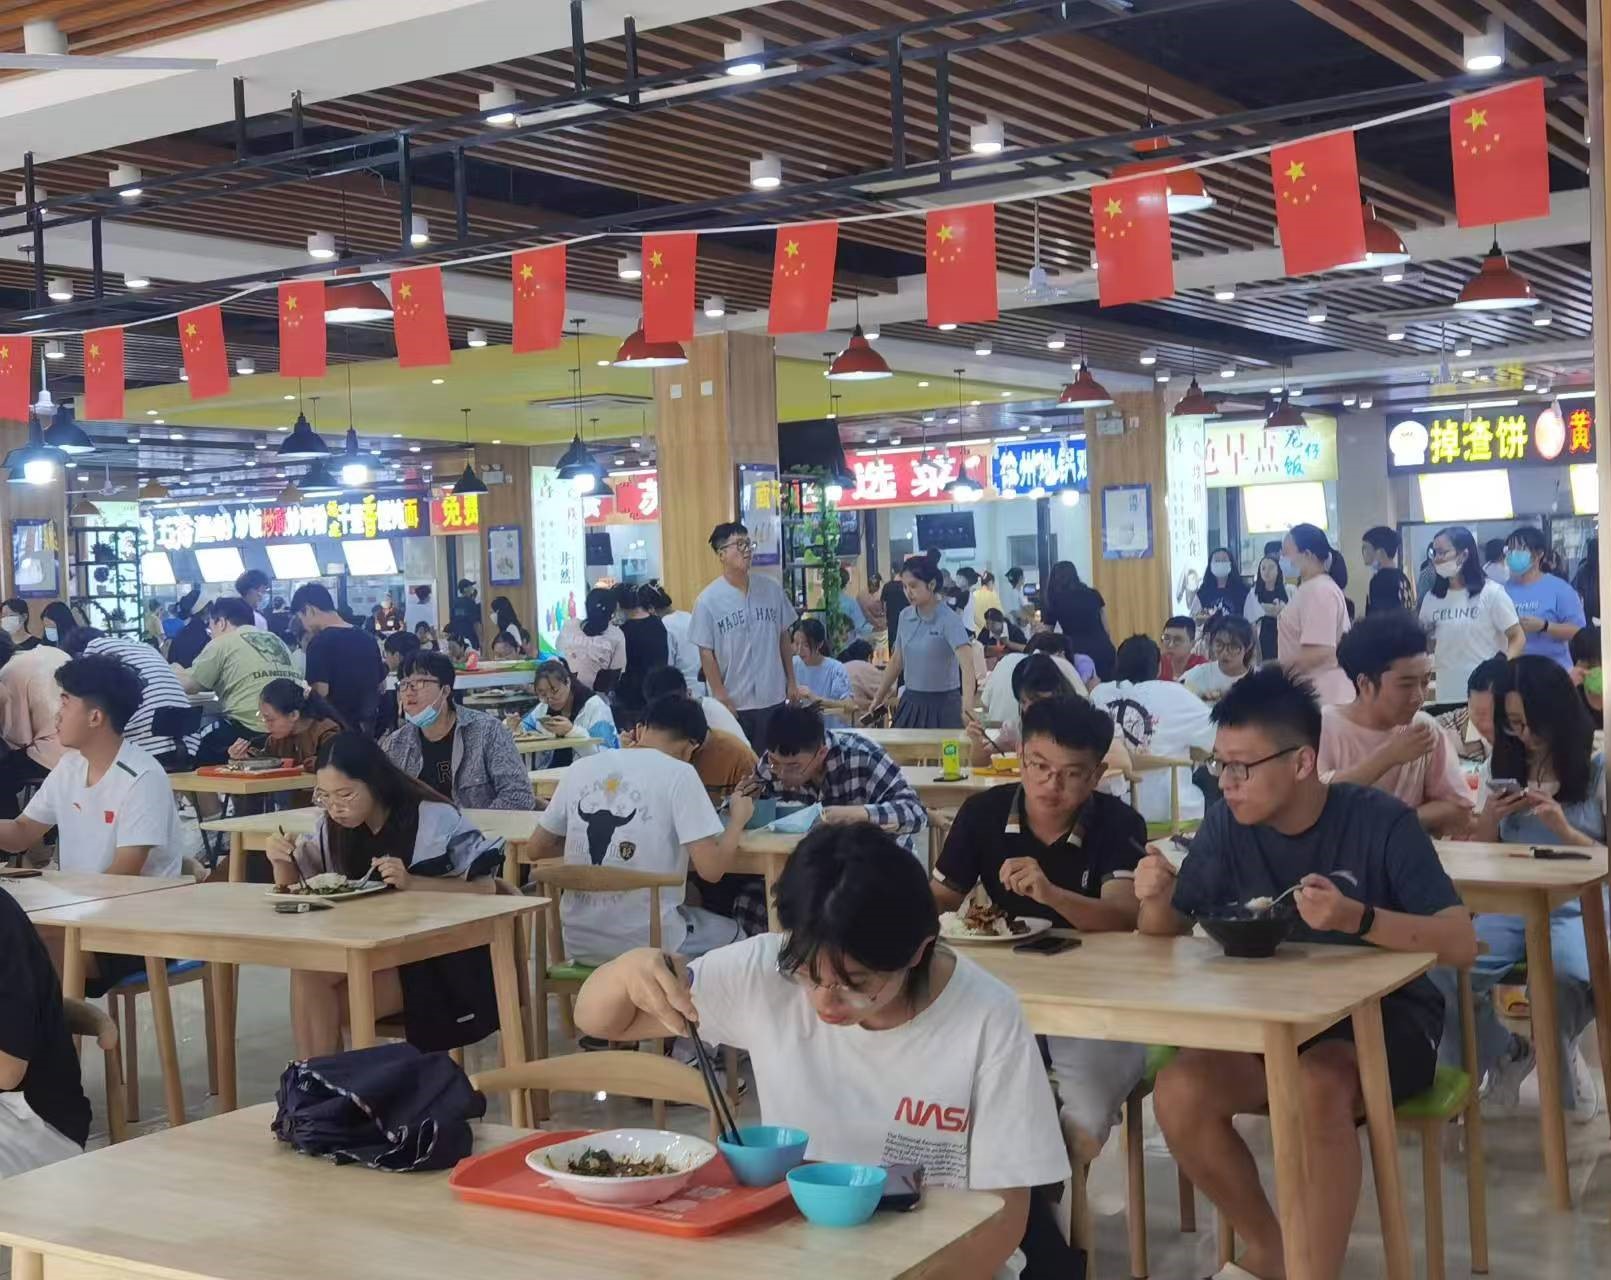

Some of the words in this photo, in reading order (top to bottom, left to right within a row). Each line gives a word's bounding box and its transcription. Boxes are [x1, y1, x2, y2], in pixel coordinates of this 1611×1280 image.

[1430, 414, 1529, 464] 掉渣饼
[717, 609, 745, 635] MADE
